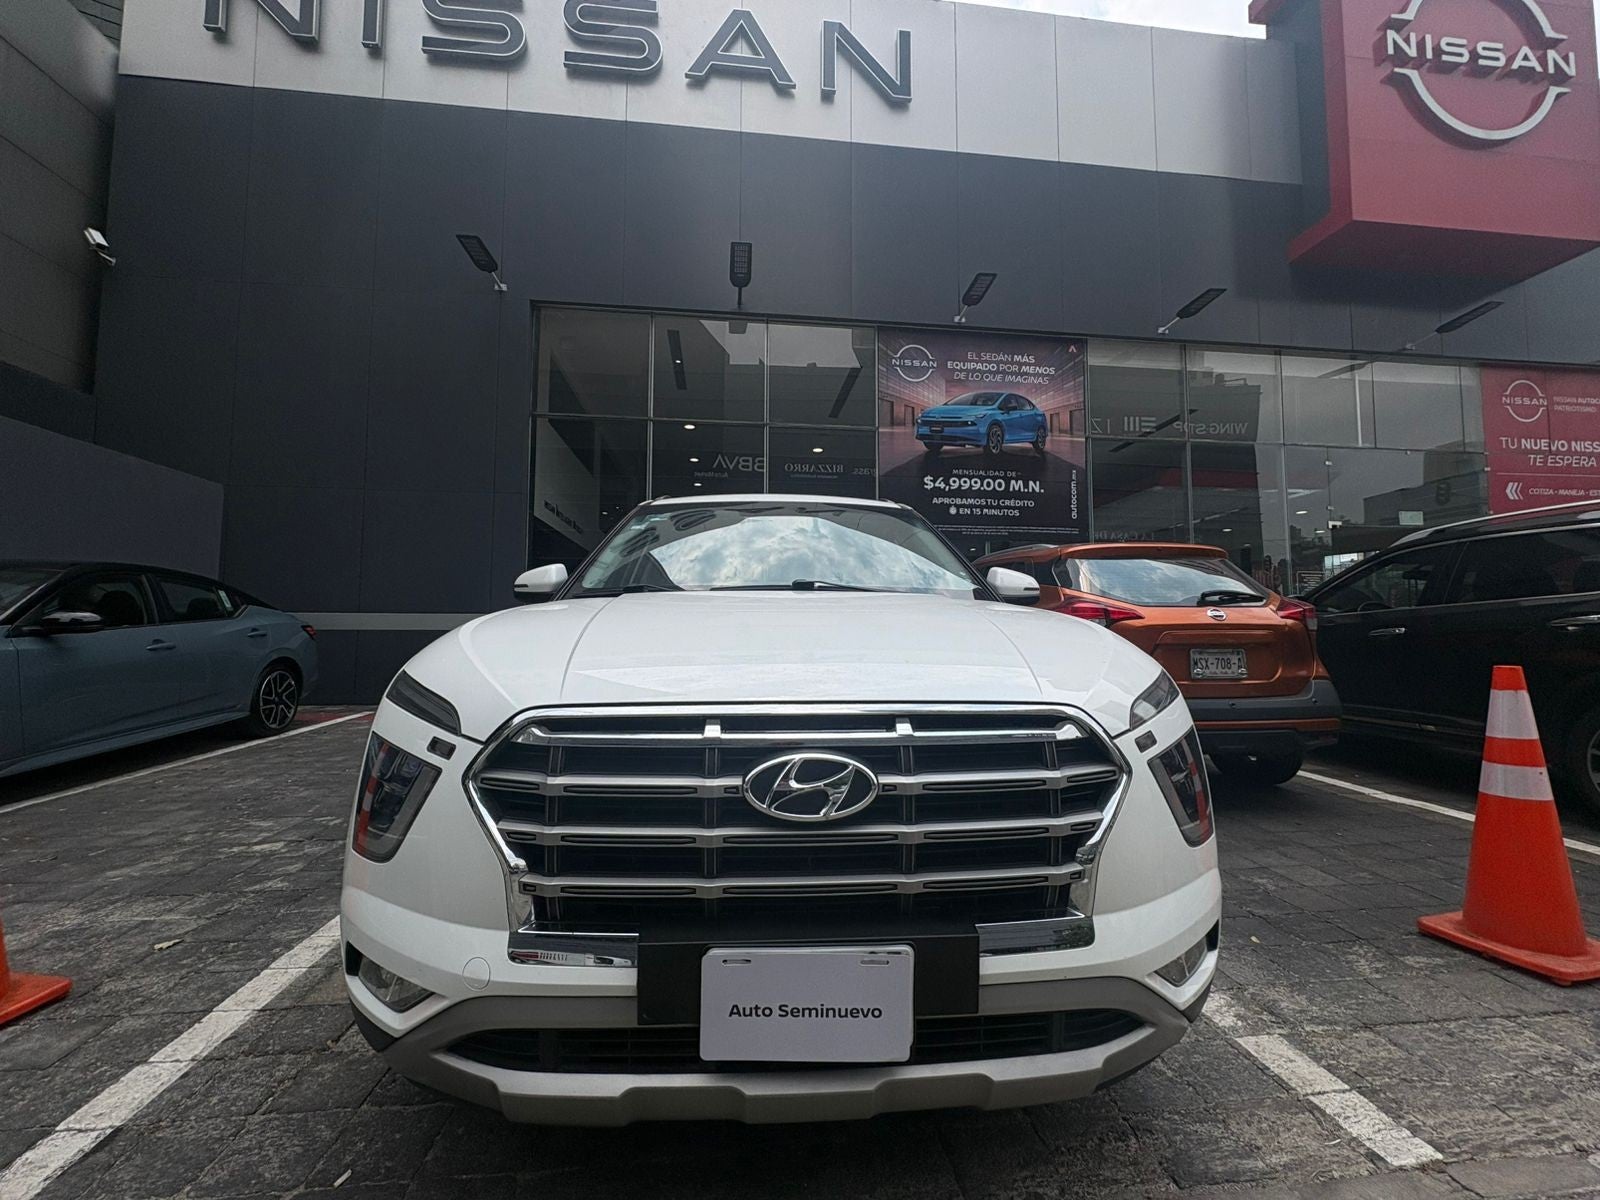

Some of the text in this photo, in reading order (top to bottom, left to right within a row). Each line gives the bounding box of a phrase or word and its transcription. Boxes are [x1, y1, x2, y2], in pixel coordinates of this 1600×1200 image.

[1386, 29, 1577, 77] NISSAN
[891, 358, 937, 368] NISSAN
[968, 351, 1035, 363] EL SEDÁN MÁS
[947, 360, 1056, 375] EQUIPADO POR MENOS
[954, 371, 1049, 385] DE LO QUE IMAGINAS
[1502, 396, 1548, 406] NISSAN
[1499, 437, 1518, 449] TU
[1521, 438, 1568, 451] NUEVO
[1527, 454, 1597, 468] TE ESPERA
[952, 468, 1005, 477] MENSUALIDAD
[923, 475, 1045, 493] $4,999.00 M.N.
[1528, 487, 1554, 495] COTIZA
[932, 497, 1035, 508] APROBAMOS TU CRÉDITO
[959, 507, 1020, 517] EN 15 MINUTOS
[728, 1003, 883, 1019] Auto Seminuevo
